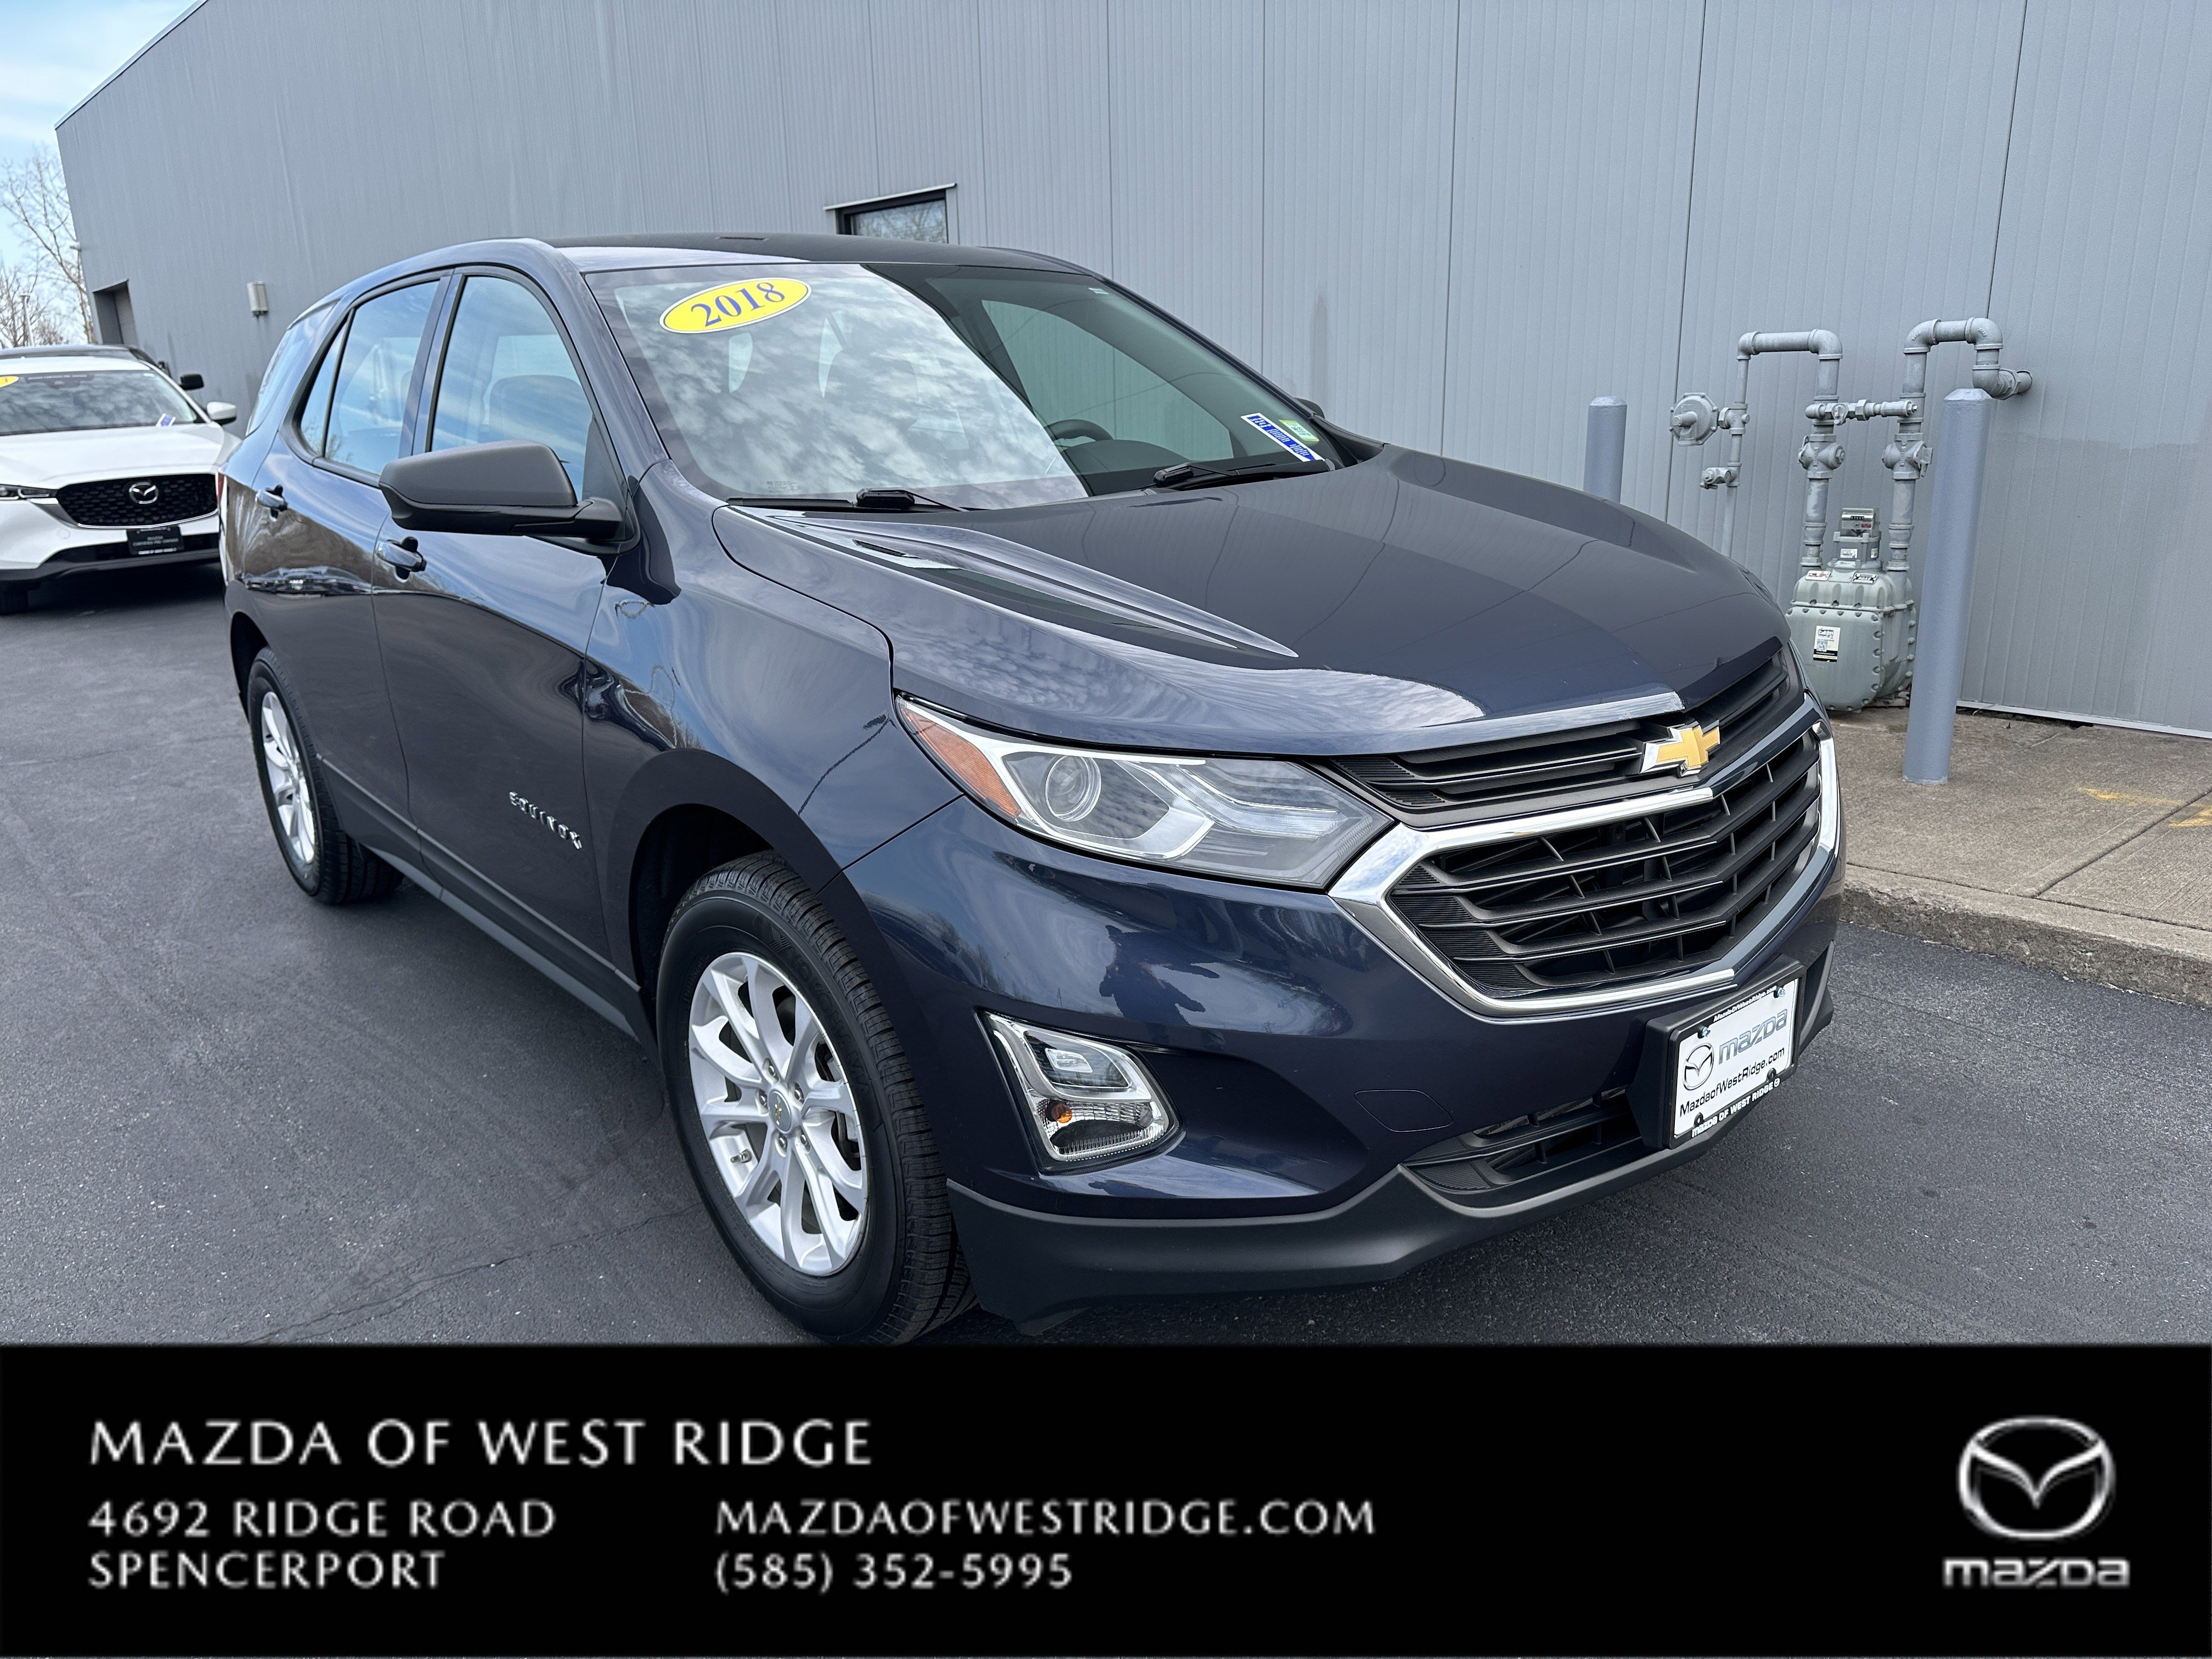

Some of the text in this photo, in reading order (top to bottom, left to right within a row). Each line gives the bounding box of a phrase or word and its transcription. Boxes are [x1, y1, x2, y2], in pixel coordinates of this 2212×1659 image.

[691, 282, 785, 327] 2018
[509, 791, 582, 849] EQUINOX
[1679, 1047, 1785, 1117] MazdaofWestRidge.com
[1719, 1109, 1729, 1121] OF
[1730, 1095, 1751, 1115] WEST
[1752, 1081, 1773, 1102] RIDGE
